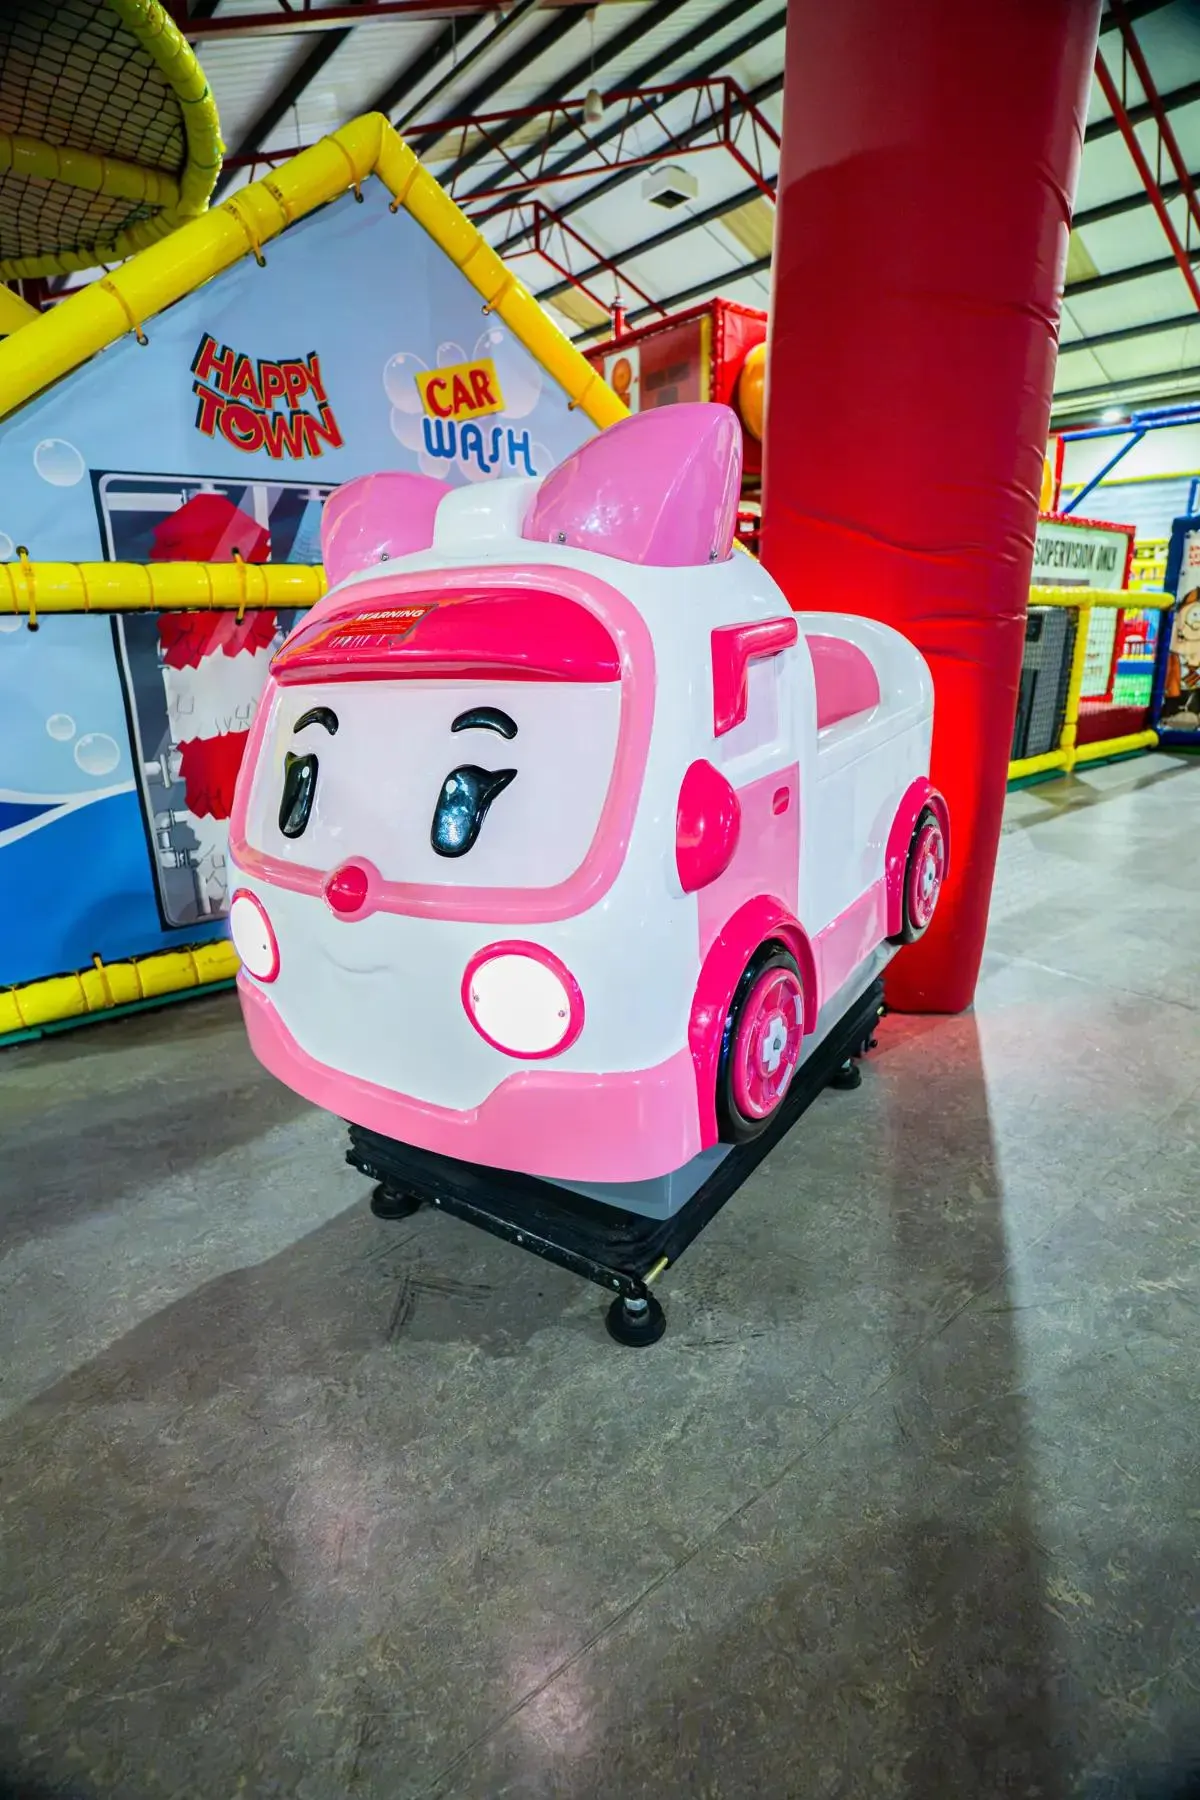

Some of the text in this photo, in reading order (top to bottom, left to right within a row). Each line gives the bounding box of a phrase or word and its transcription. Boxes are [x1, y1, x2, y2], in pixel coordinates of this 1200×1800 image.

[190, 332, 328, 410] HAPPY
[425, 368, 498, 418] CAR
[192, 380, 344, 461] TOWN
[422, 416, 538, 477] WASH
[1034, 538, 1096, 571] SUPERVISION
[355, 609, 425, 621] WARNING
